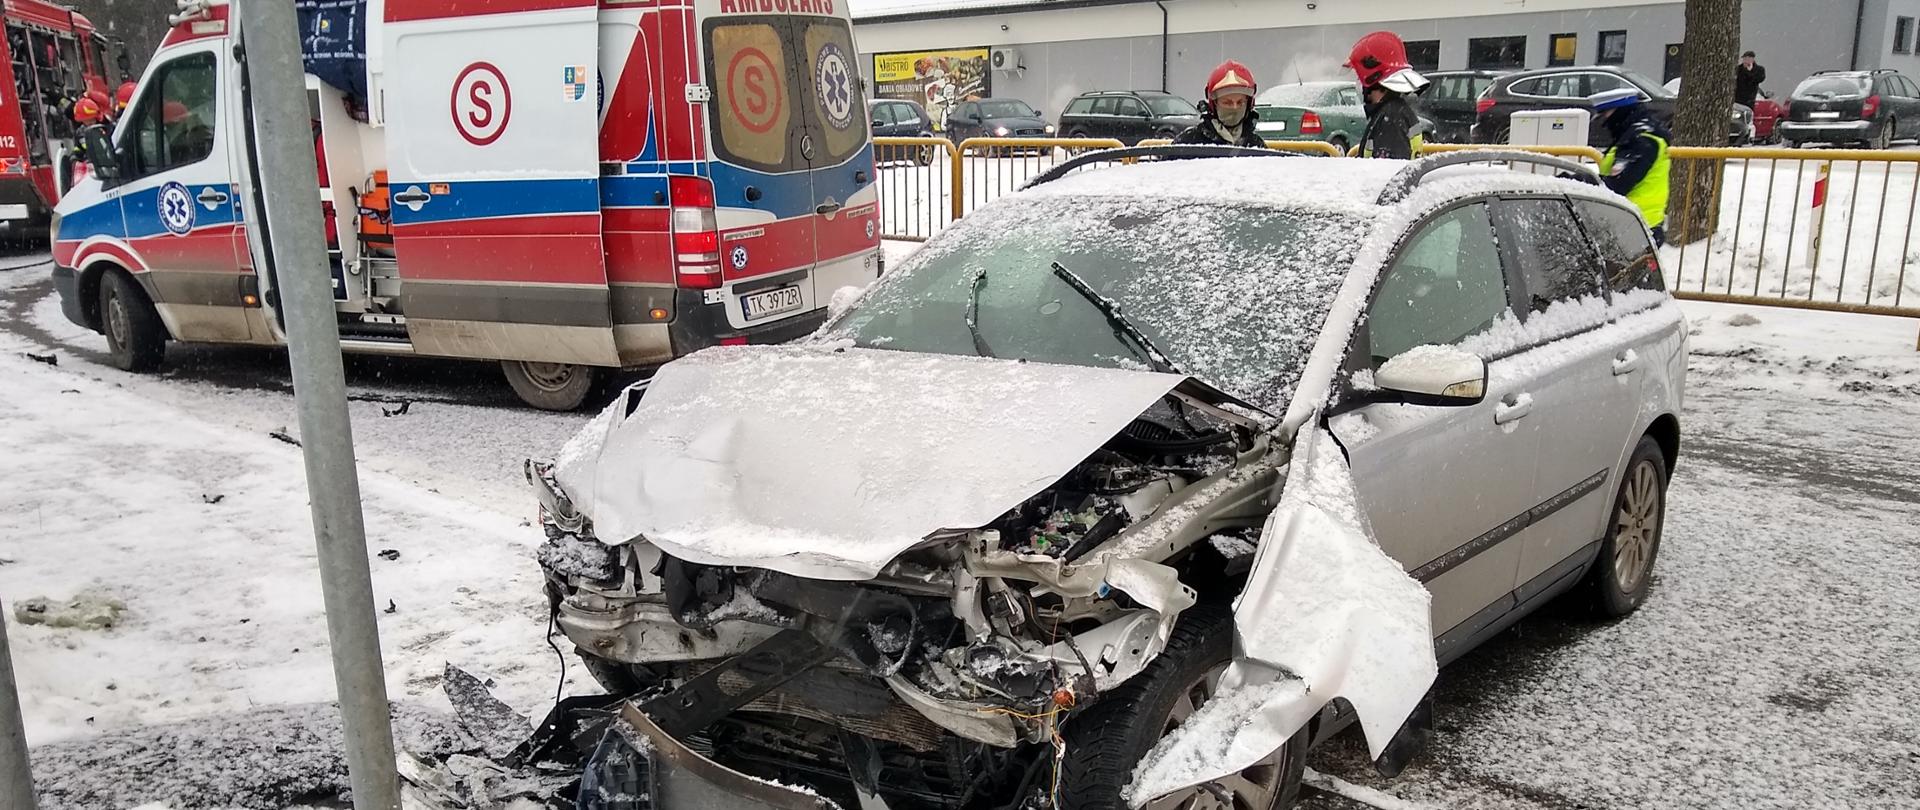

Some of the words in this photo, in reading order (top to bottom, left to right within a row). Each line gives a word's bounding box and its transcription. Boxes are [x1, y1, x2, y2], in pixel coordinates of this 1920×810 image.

[885, 60, 909, 72] BISTRO
[469, 80, 492, 128] S
[744, 65, 767, 115] S
[750, 295, 766, 313] TK
[766, 288, 799, 309] 3972R
